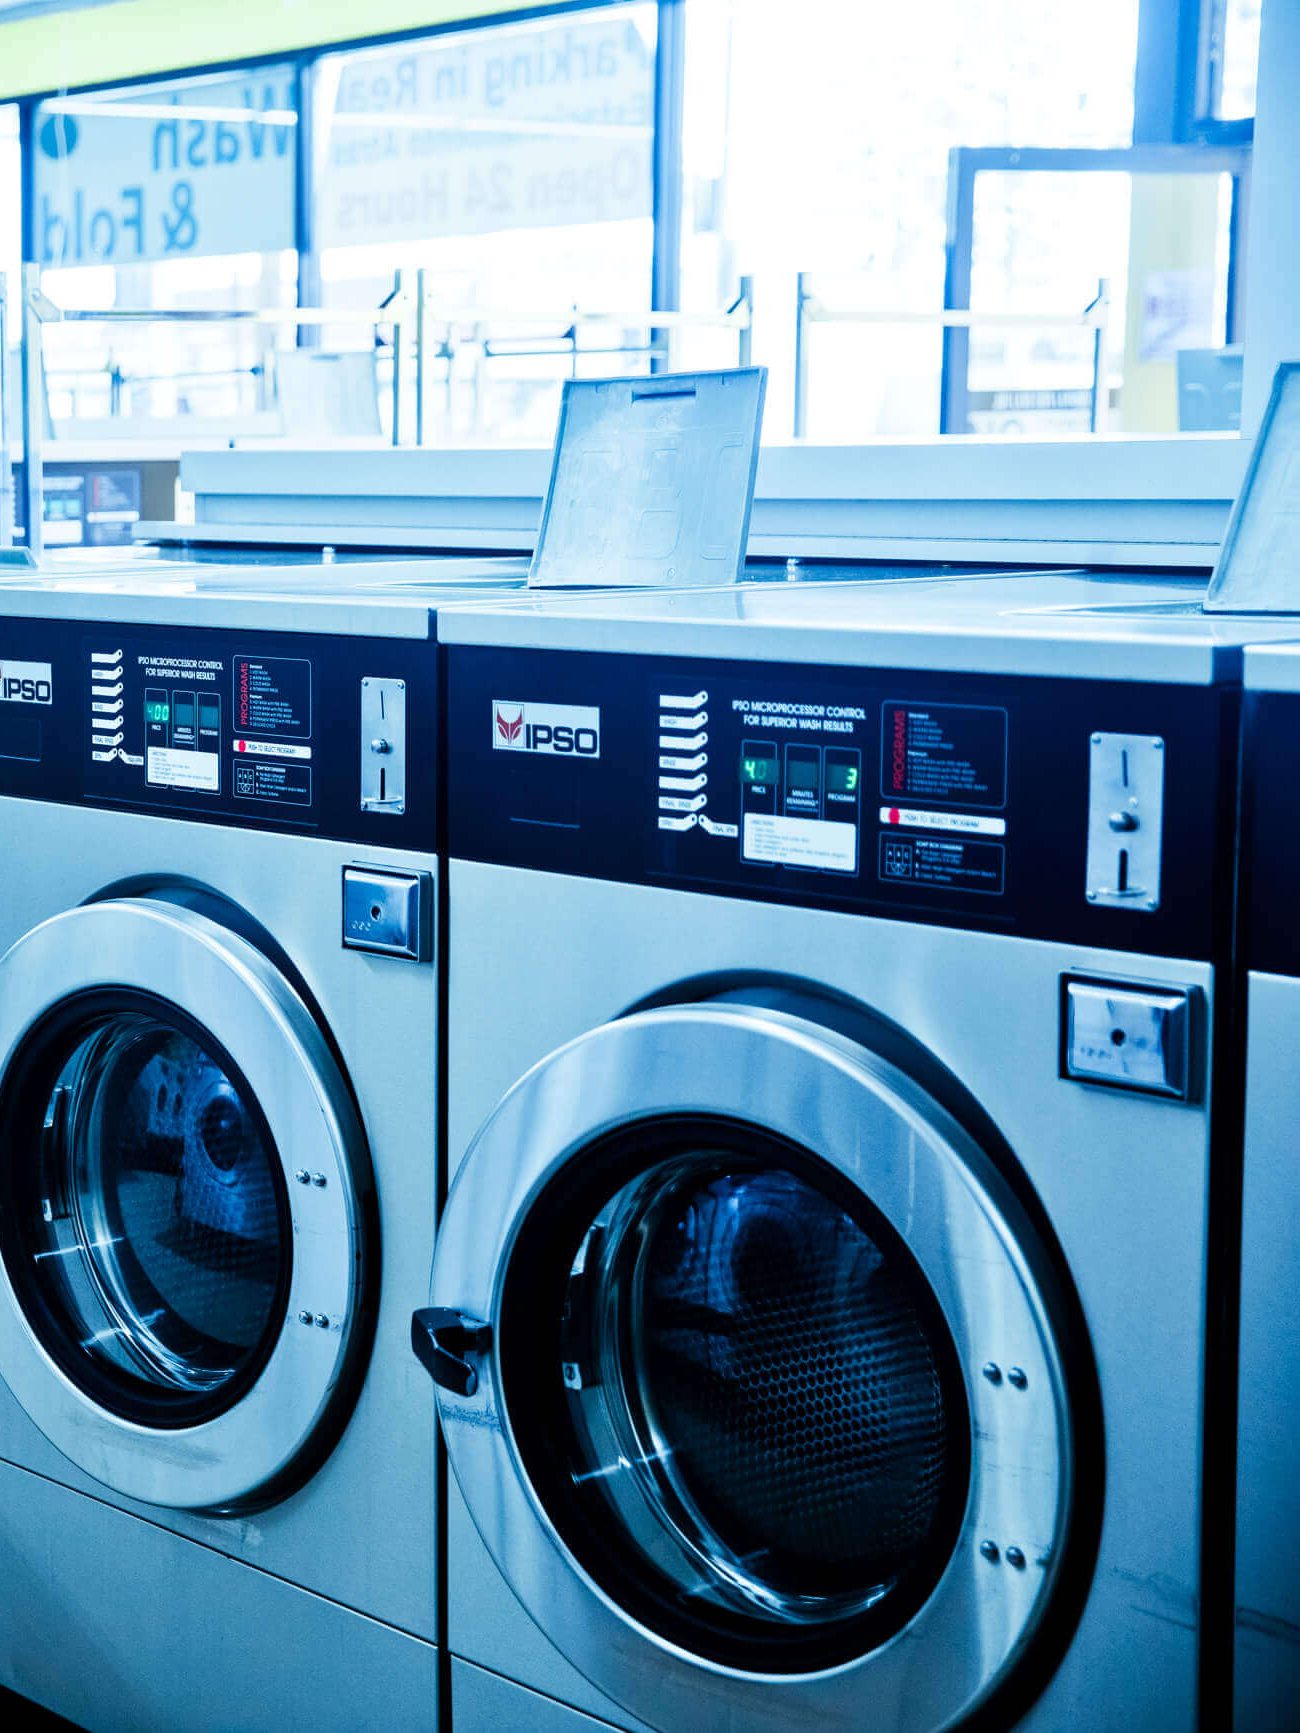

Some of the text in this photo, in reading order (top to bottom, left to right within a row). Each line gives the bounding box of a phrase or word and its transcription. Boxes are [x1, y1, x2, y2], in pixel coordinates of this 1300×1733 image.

[3, 677, 51, 702] IPSO
[732, 699, 867, 720] IPSO MICROPROCESSOR CONTROL
[743, 714, 854, 733] FOR SUPERIOR WASH RESULTS
[526, 723, 598, 754] IPSO
[893, 710, 905, 790] PROGRAMS
[845, 767, 858, 790] 3
